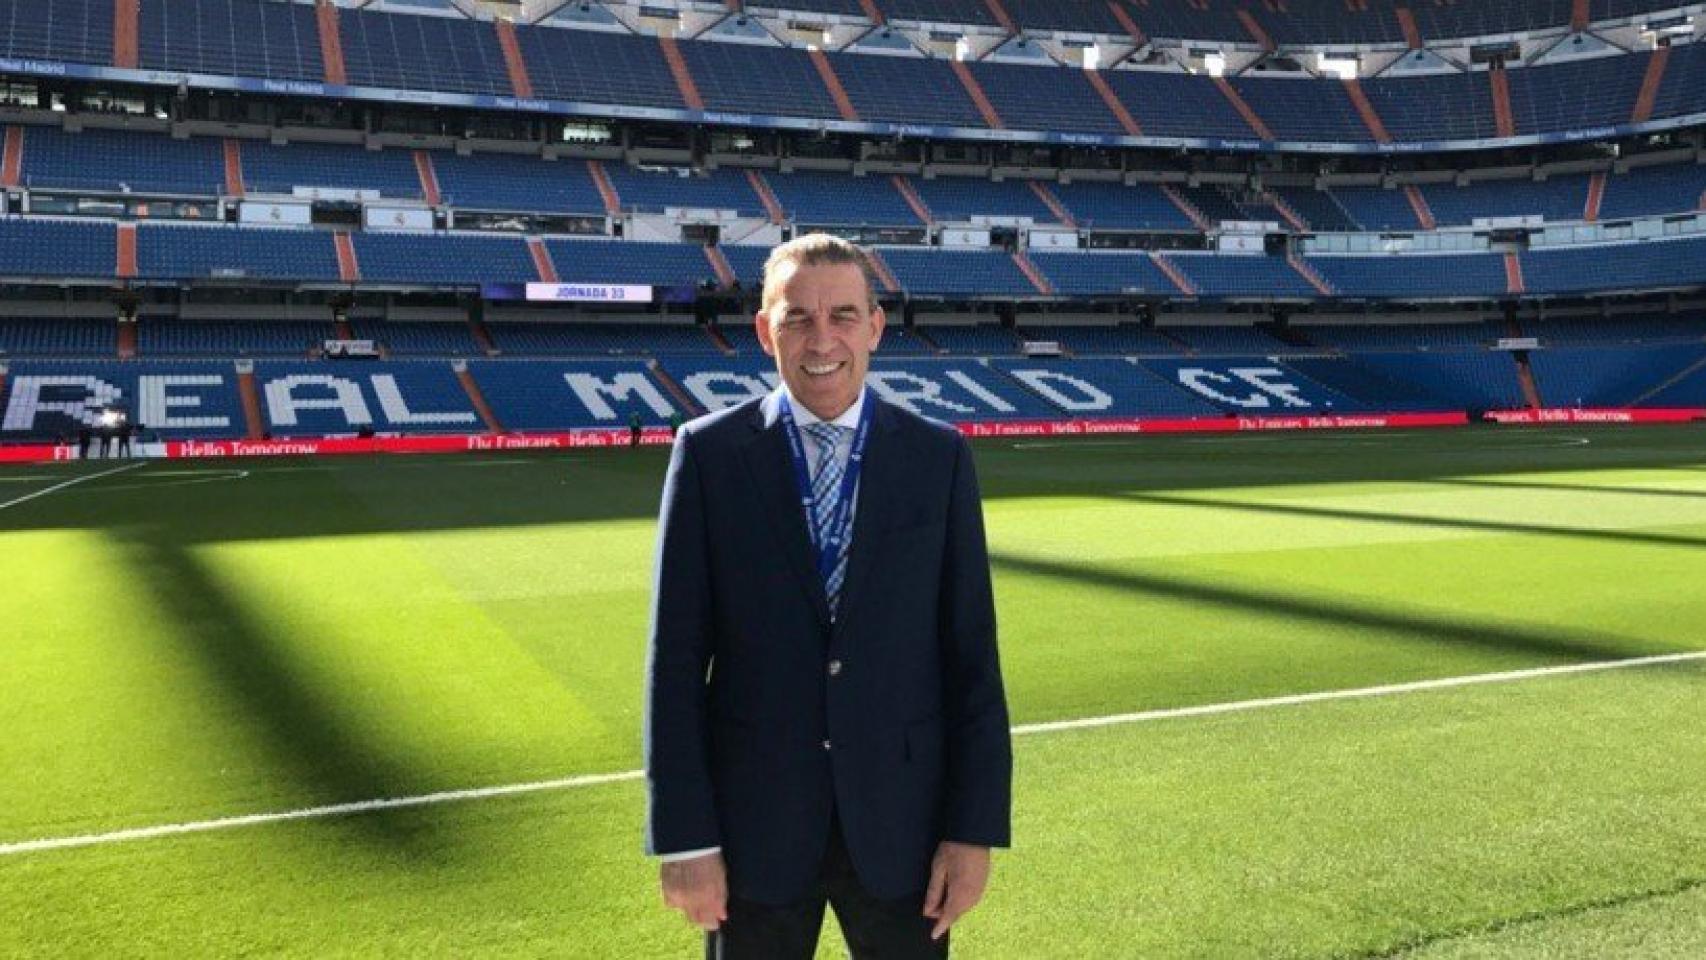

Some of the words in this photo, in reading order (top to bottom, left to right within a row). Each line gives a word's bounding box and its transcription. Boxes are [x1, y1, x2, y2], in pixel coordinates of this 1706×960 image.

[555, 286, 608, 299] JORNADA
[2, 373, 477, 431] REAL
[563, 368, 1113, 420] MARID
[1052, 422, 1081, 434] Hello
[569, 432, 606, 446] Hello
[181, 440, 225, 457] Hello
[231, 442, 318, 456] Tomorrow
